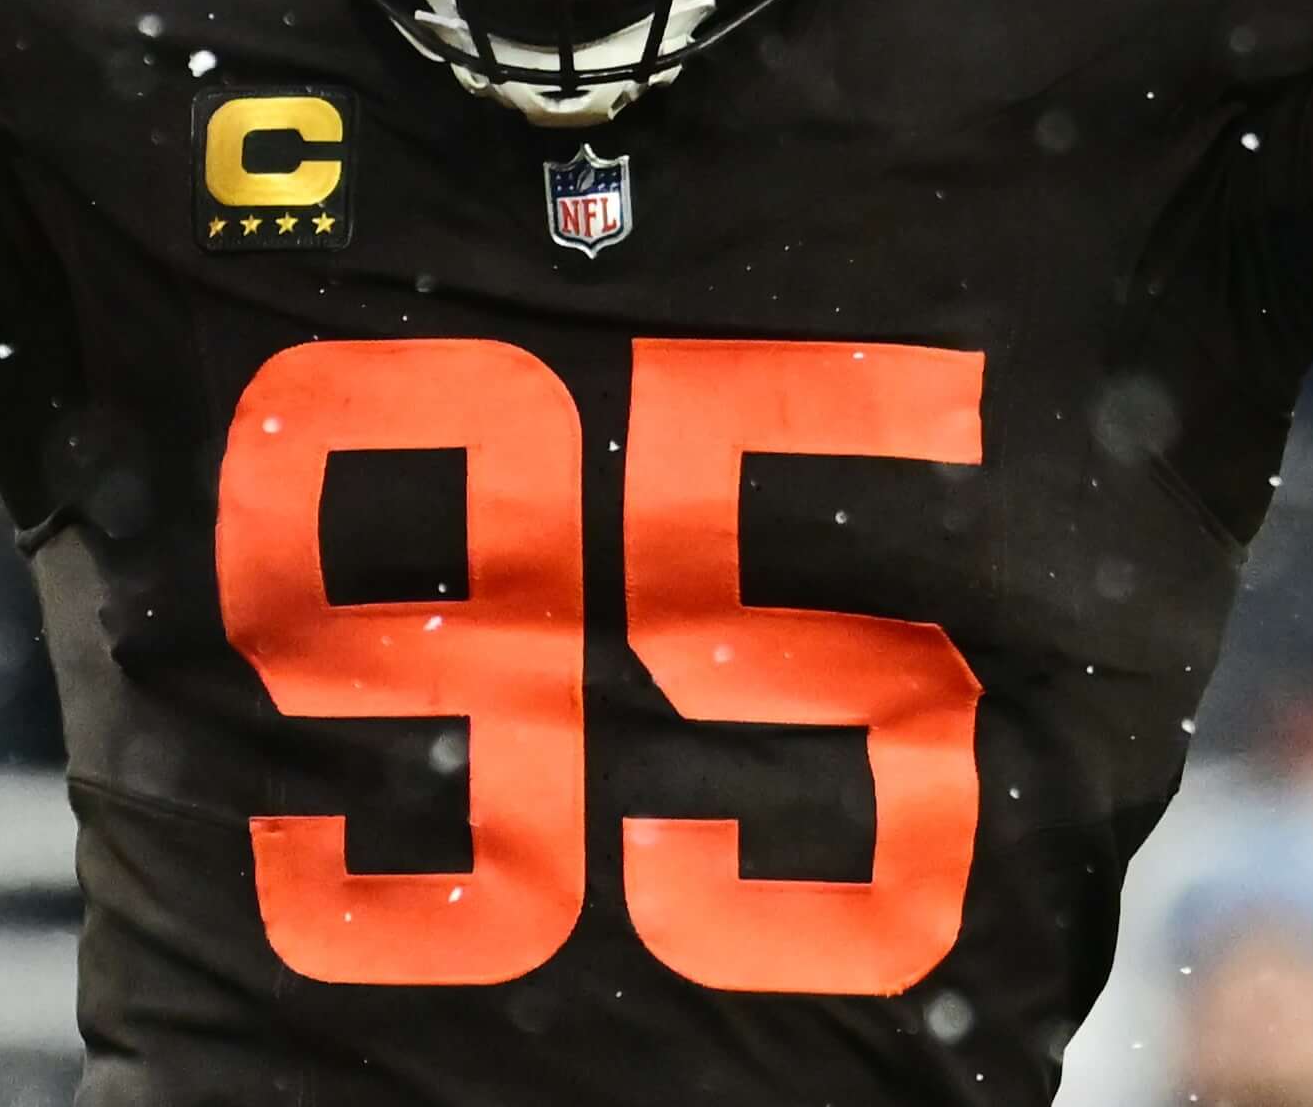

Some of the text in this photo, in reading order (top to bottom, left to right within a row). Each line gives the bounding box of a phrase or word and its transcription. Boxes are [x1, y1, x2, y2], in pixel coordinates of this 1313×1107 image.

[205, 96, 343, 207] C
[559, 196, 617, 237] NFL
[215, 337, 985, 997] 95
